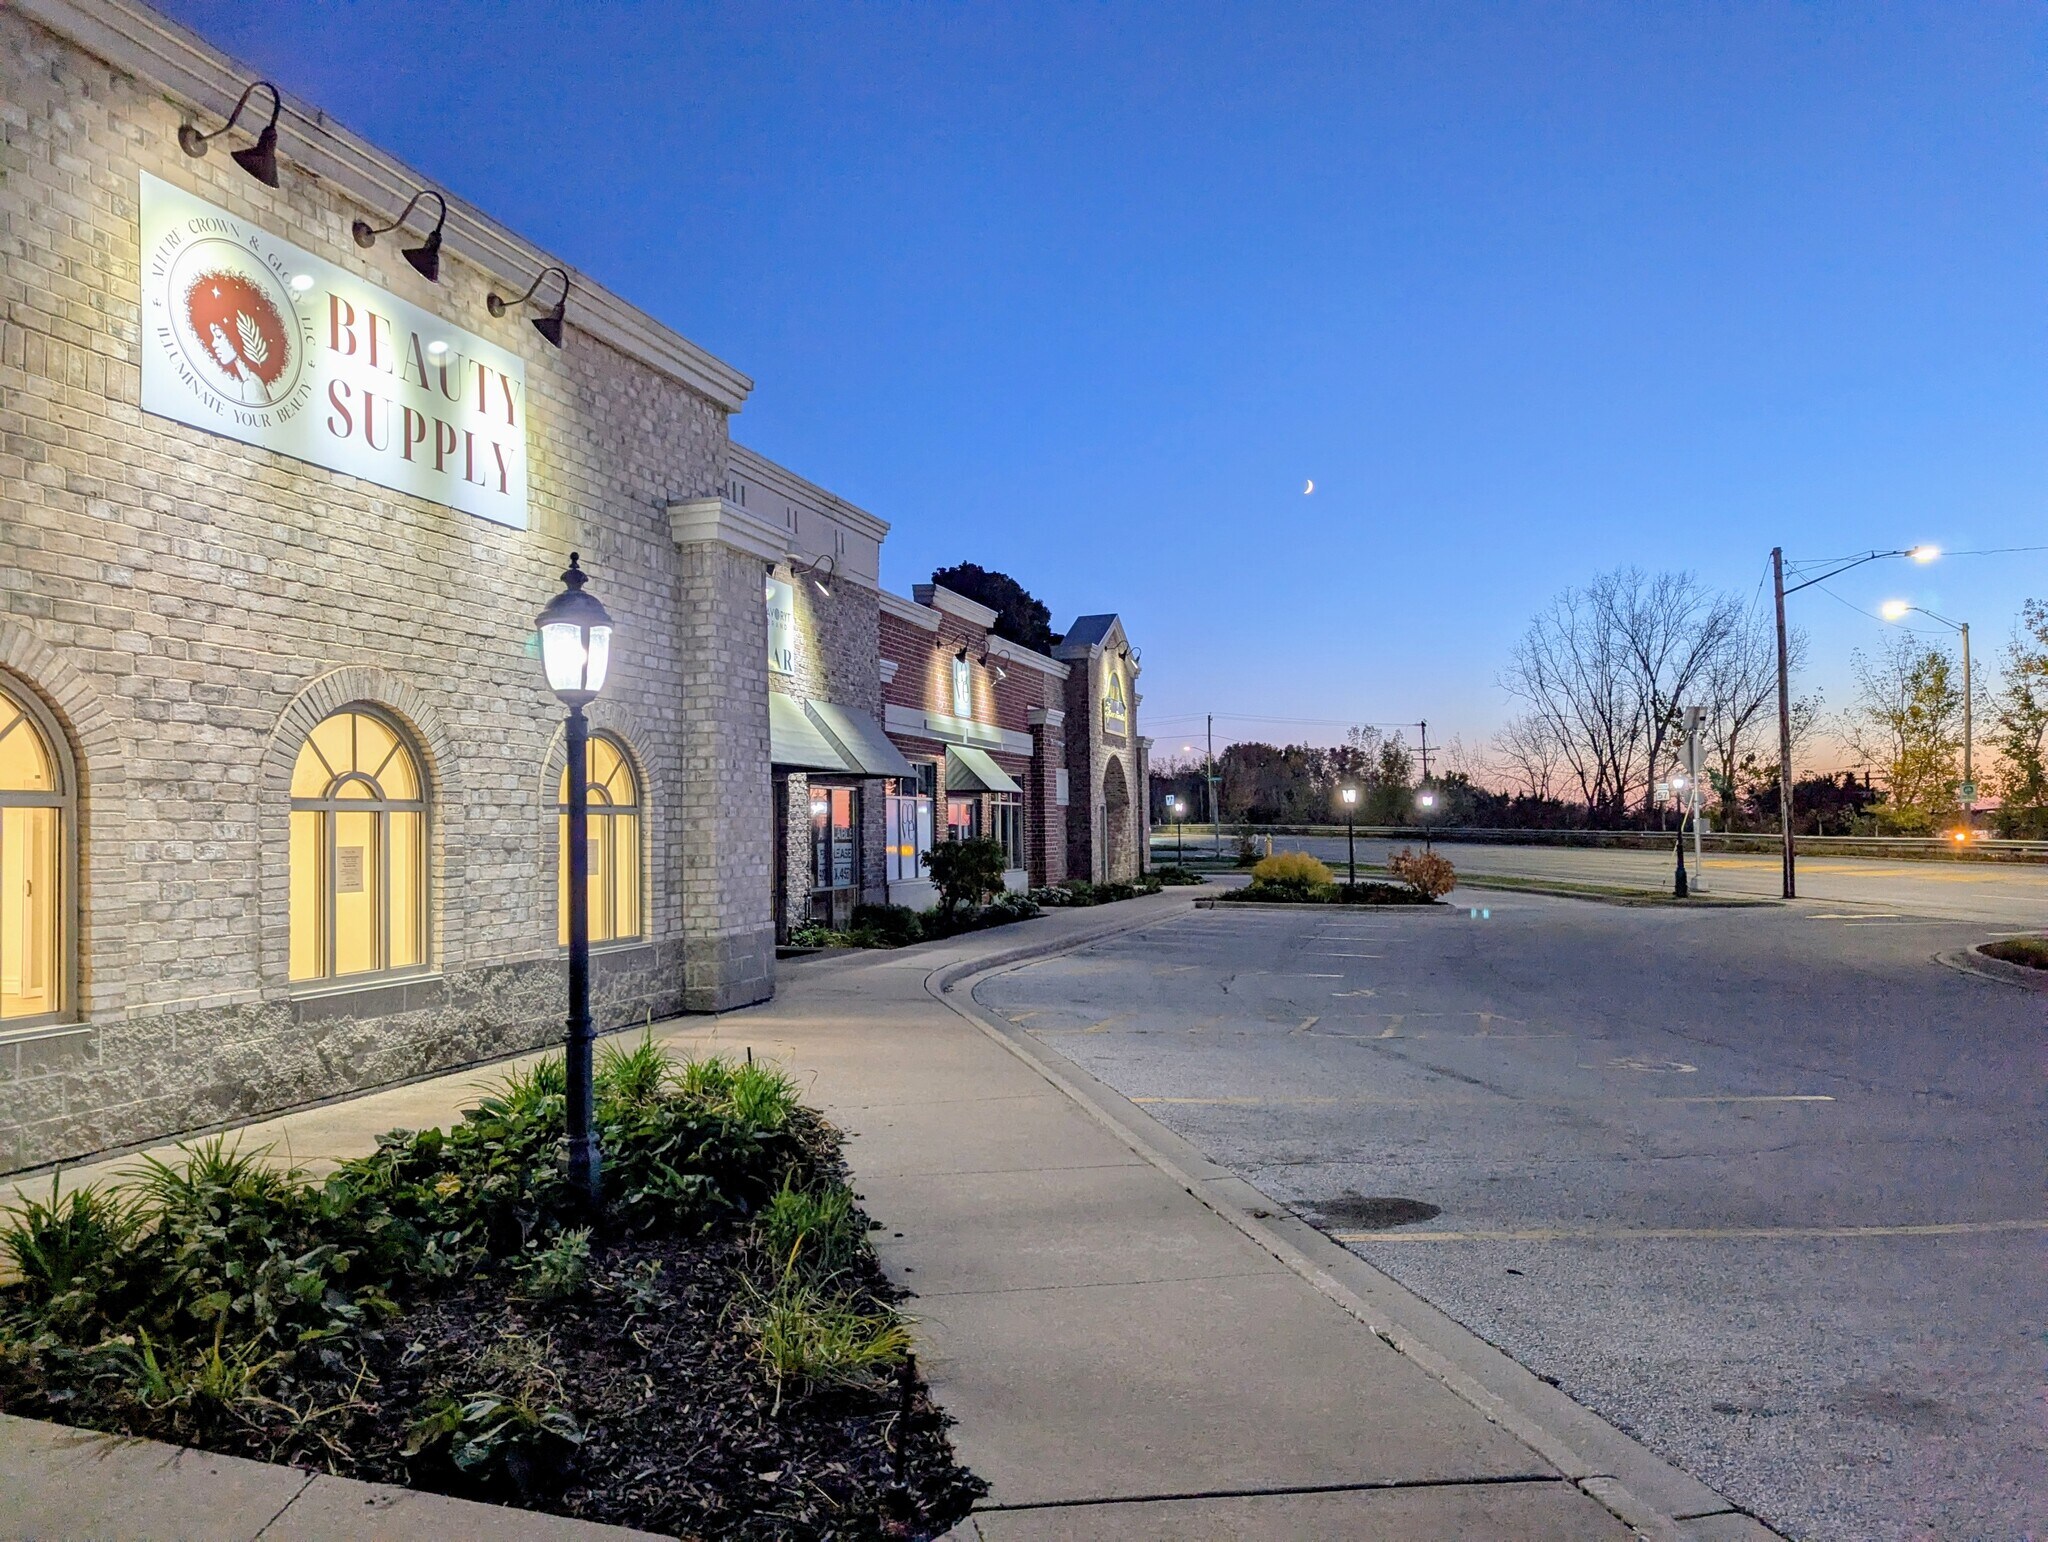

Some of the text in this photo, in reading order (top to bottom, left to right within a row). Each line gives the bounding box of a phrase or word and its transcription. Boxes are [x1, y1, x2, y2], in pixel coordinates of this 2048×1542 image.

[188, 217, 240, 238] CROWN
[249, 235, 260, 251] &
[267, 252, 305, 304] GLOY
[157, 327, 313, 428] ILLUMINATE YOUR BEAUTY
[325, 291, 521, 428] BEAUTY
[327, 378, 515, 496] SUPPLY
[773, 647, 793, 672] AR
[1657, 791, 1668, 800] 57
